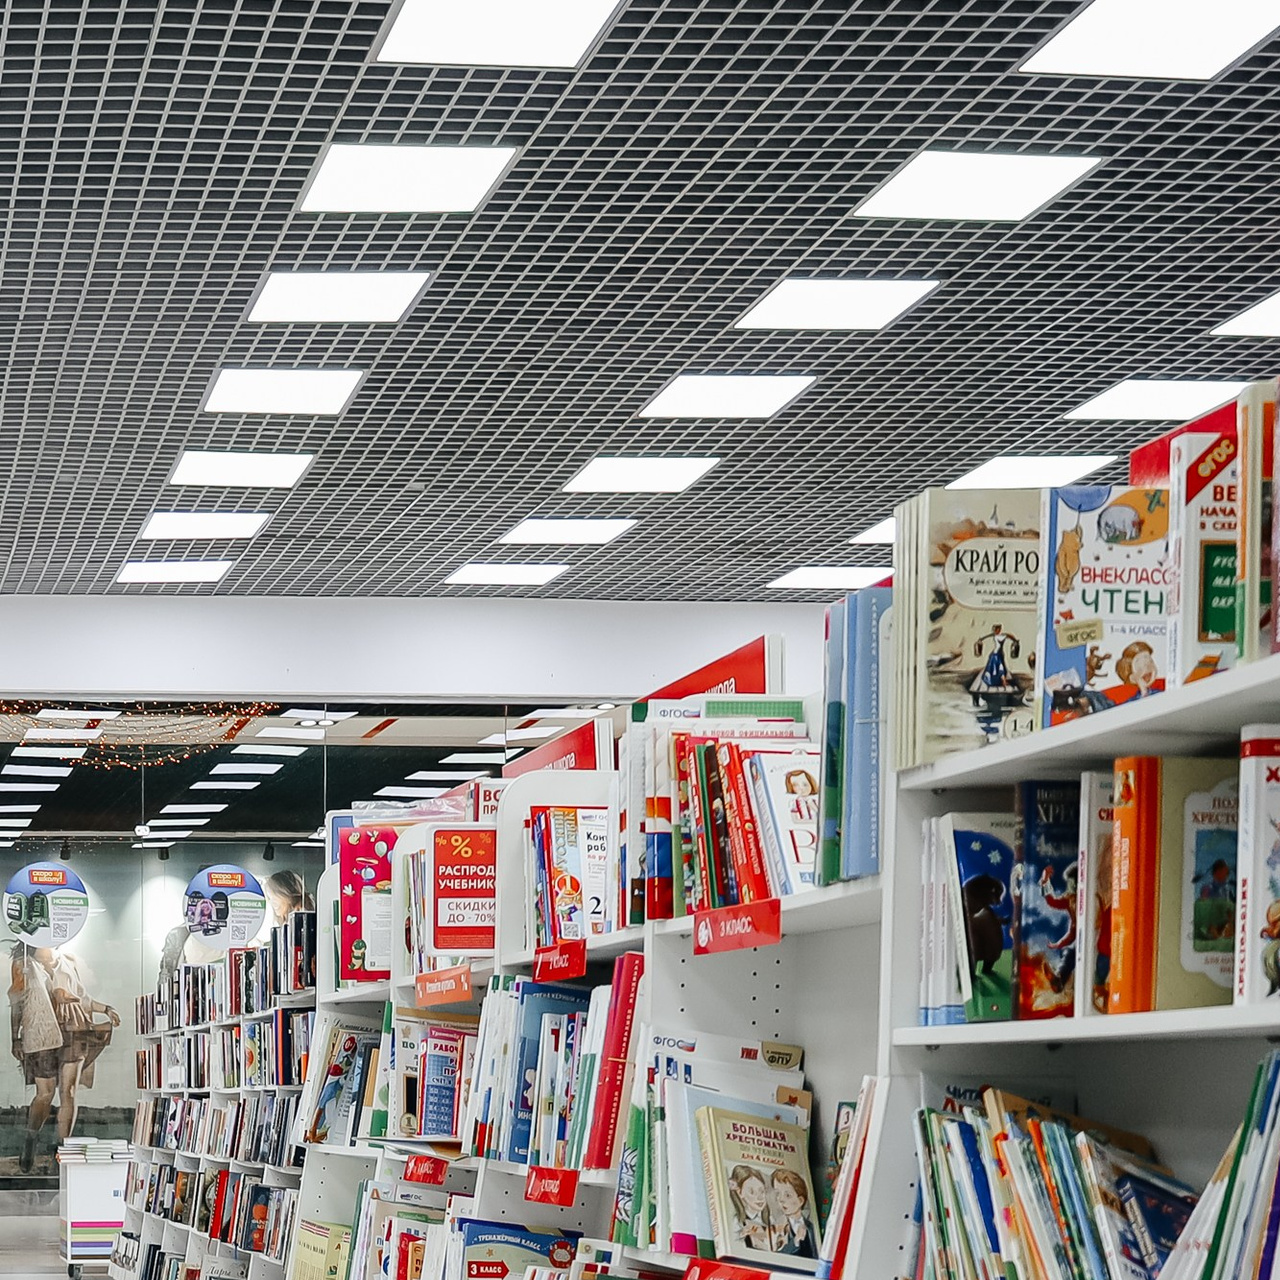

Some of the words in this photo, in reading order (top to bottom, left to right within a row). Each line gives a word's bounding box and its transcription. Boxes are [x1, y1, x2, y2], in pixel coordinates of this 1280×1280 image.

[953, 544, 1007, 574] КРАЙ
[1014, 552, 1039, 574] РО
[1080, 588, 1165, 615] ЧТЕН
[451, 835, 472, 858] %
[438, 865, 495, 877] РАСПРОД
[438, 878, 496, 890] УЧЕБНИК
[447, 901, 496, 911] СКИДКИ
[590, 897, 602, 914] 2
[447, 913, 465, 924] ДО
[726, 916, 752, 936] КЛАСС
[767, 1054, 791, 1066] ФПУ
[732, 1122, 787, 1142] БОЛЬШАЯ
[725, 1132, 796, 1153] ХРЕСТОМАТИЯ
[521, 1239, 541, 1251] КЛАСС
[470, 1264, 477, 1275] 3
[479, 1265, 502, 1274] КЛАСС
